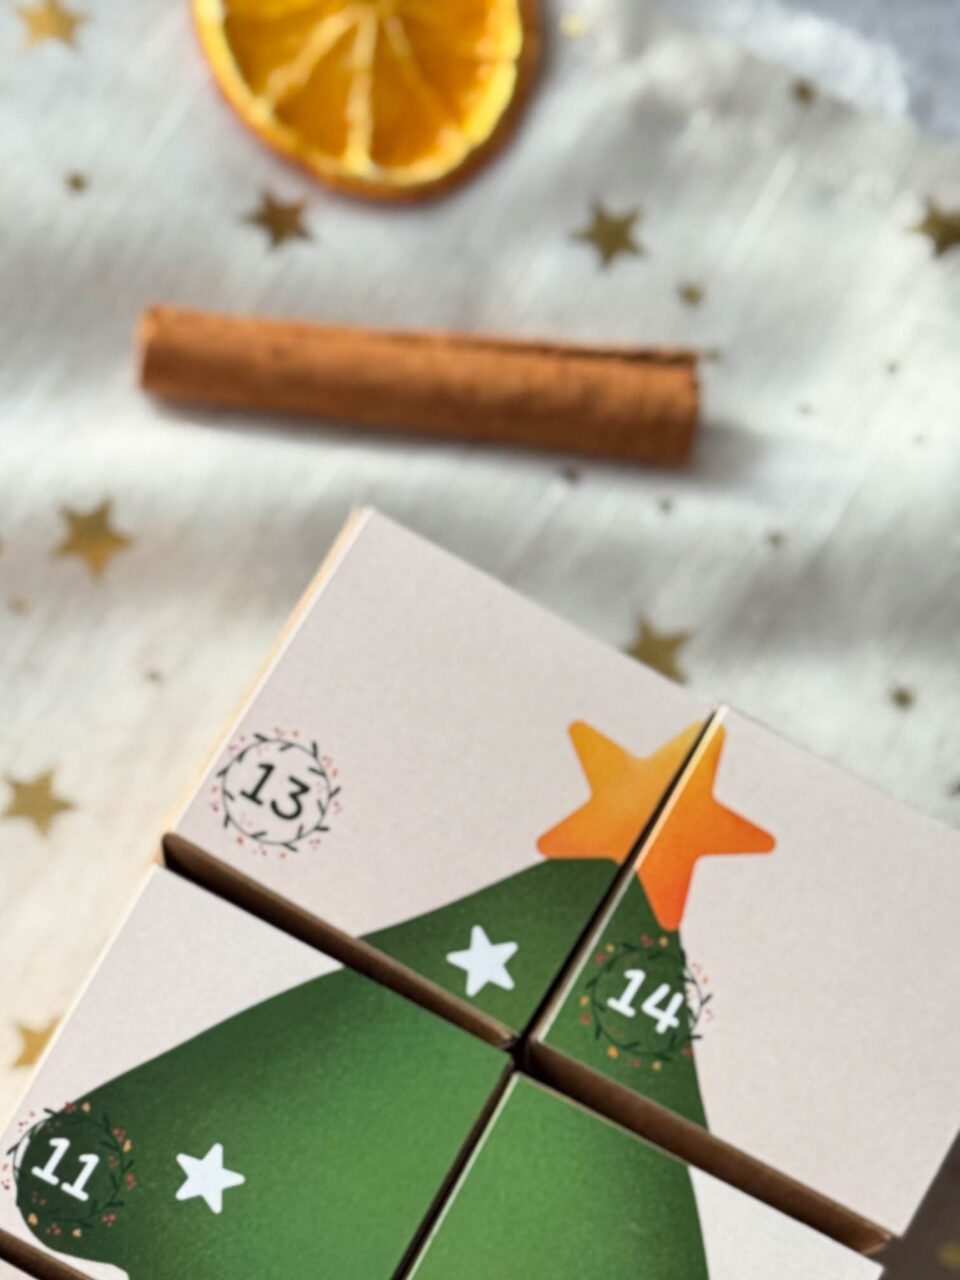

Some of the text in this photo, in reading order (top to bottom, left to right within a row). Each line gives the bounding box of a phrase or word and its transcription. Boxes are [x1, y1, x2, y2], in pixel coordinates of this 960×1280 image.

[239, 763, 311, 821] 13
[606, 969, 684, 1034] 14
[31, 1137, 100, 1202] 11
